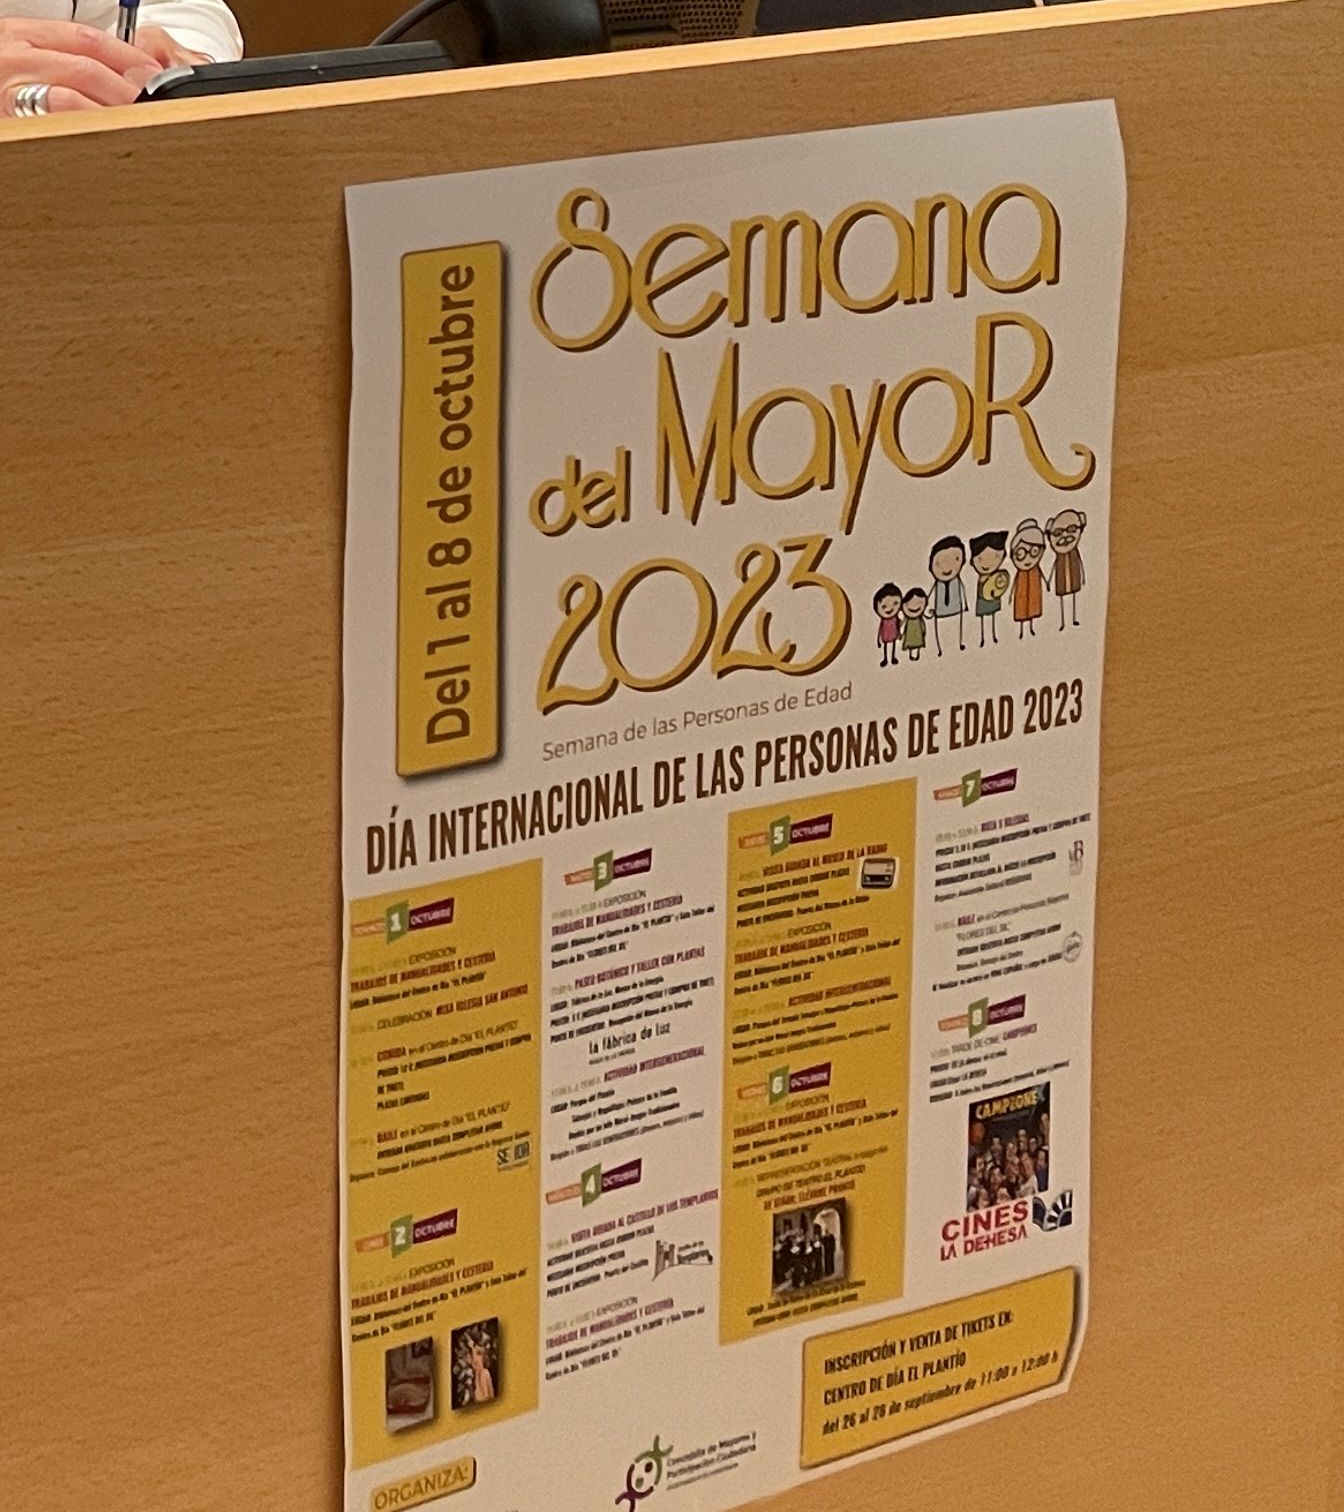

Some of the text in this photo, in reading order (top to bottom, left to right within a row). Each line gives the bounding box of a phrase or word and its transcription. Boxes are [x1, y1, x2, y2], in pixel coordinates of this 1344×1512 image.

[529, 183, 1060, 352] Semana
[425, 264, 474, 744] Del 1 al 8 de octubre
[529, 447, 632, 536] del
[537, 533, 852, 716] 2023
[543, 681, 852, 762] Semana de las Personas de Edad
[368, 678, 1083, 875] DÍA INTERNACIONAL DE LAS PERSONAS DE EDAD 2023
[966, 780, 975, 797] 7
[774, 826, 784, 844] 5
[598, 861, 607, 880] 3
[390, 913, 401, 932] 1
[589, 1023, 670, 1054] la fábrica de luz
[772, 1076, 782, 1093] 6
[586, 1174, 596, 1192] 4
[395, 1219, 455, 1245] 2 OCTUBRE
[941, 1200, 1028, 1240] CINES
[940, 1225, 1028, 1261] LA DEHESA
[825, 1339, 896, 1375] INSCRIPCIÓN
[900, 1338, 906, 1354] Y
[910, 1331, 941, 1352] VENTA
[945, 1325, 959, 1343] DE
[963, 1315, 996, 1338] TIKETS
[824, 1351, 966, 1405] CENTRO DE DÍA EL PLANTÍO
[374, 1468, 468, 1510] ORGANIZA:
